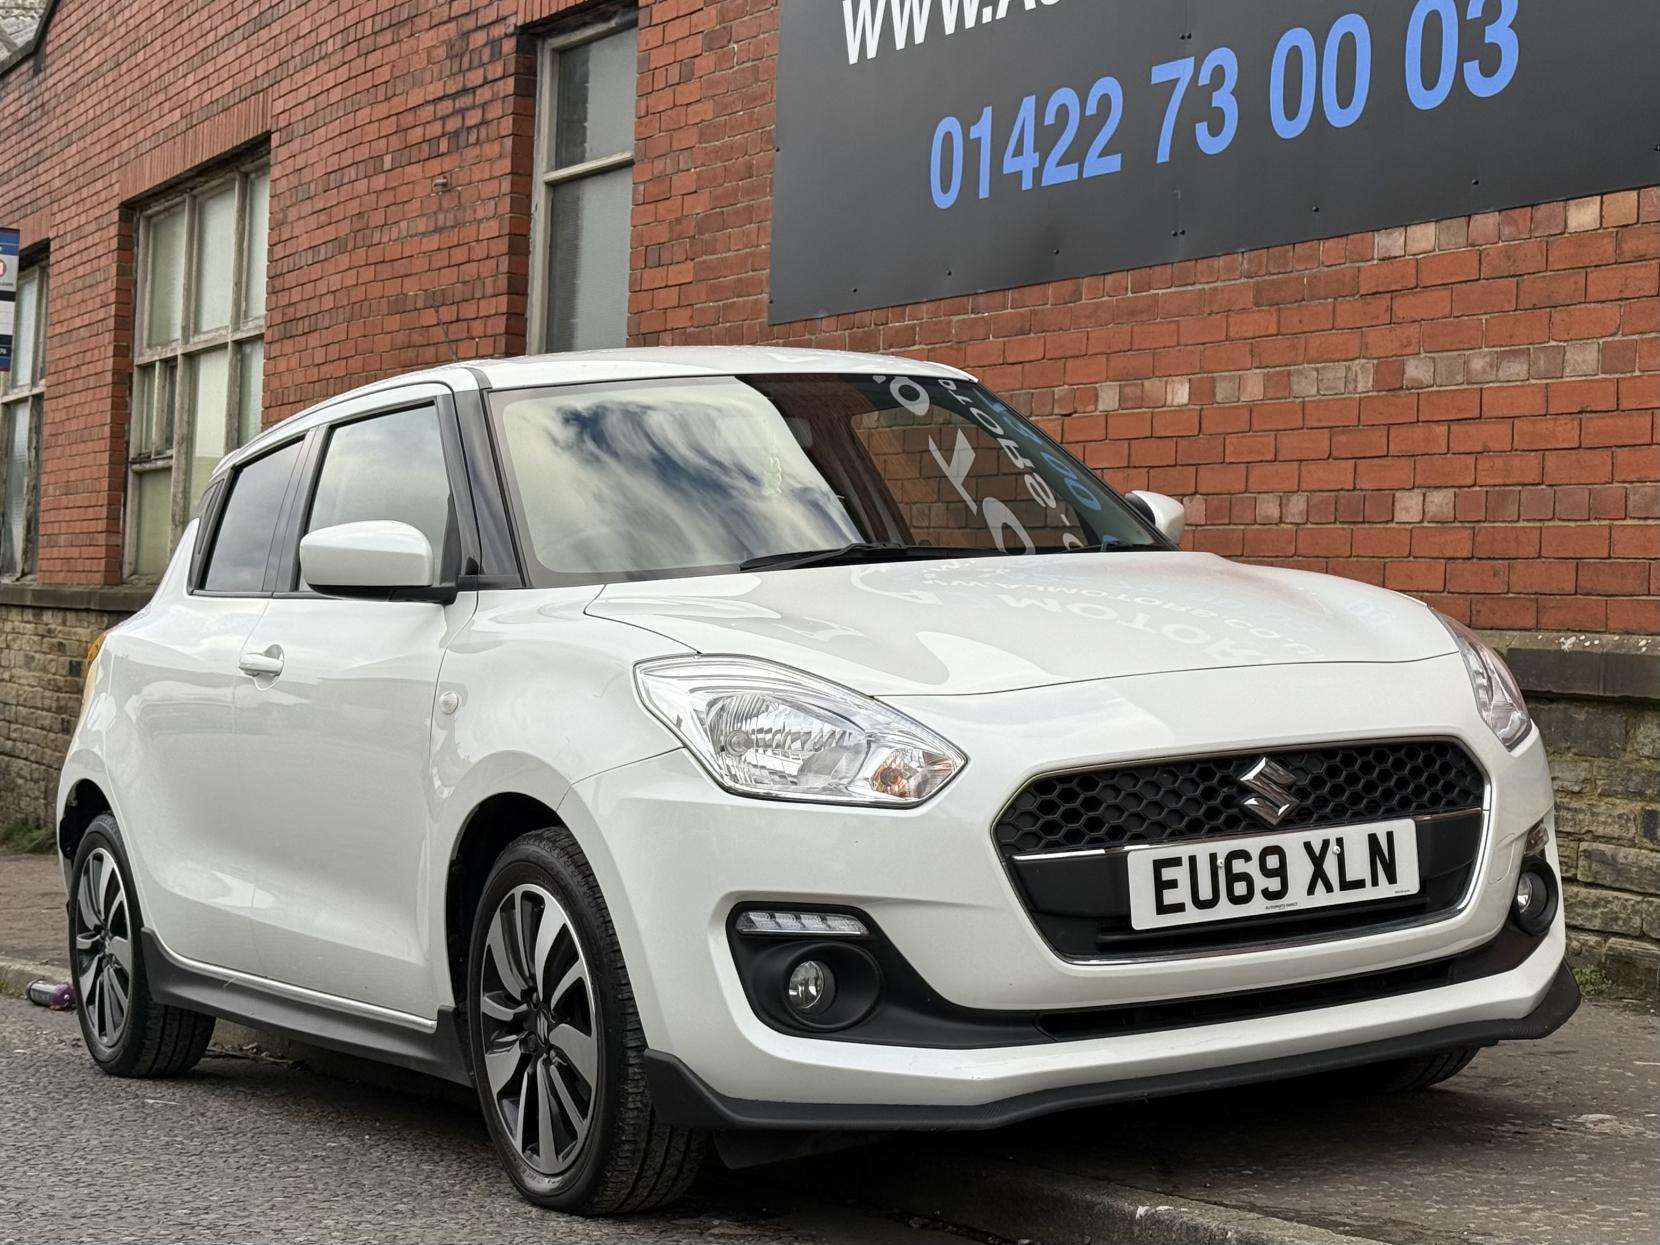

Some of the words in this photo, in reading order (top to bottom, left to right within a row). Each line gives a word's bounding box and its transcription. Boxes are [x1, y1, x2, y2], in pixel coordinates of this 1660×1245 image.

[930, 77, 1123, 209] 01422
[1151, 47, 1239, 164] 73
[1269, 13, 1372, 140] 00
[1404, 0, 1519, 110] 03
[1152, 845, 1289, 916] EU69
[1303, 830, 1398, 896] XLN
